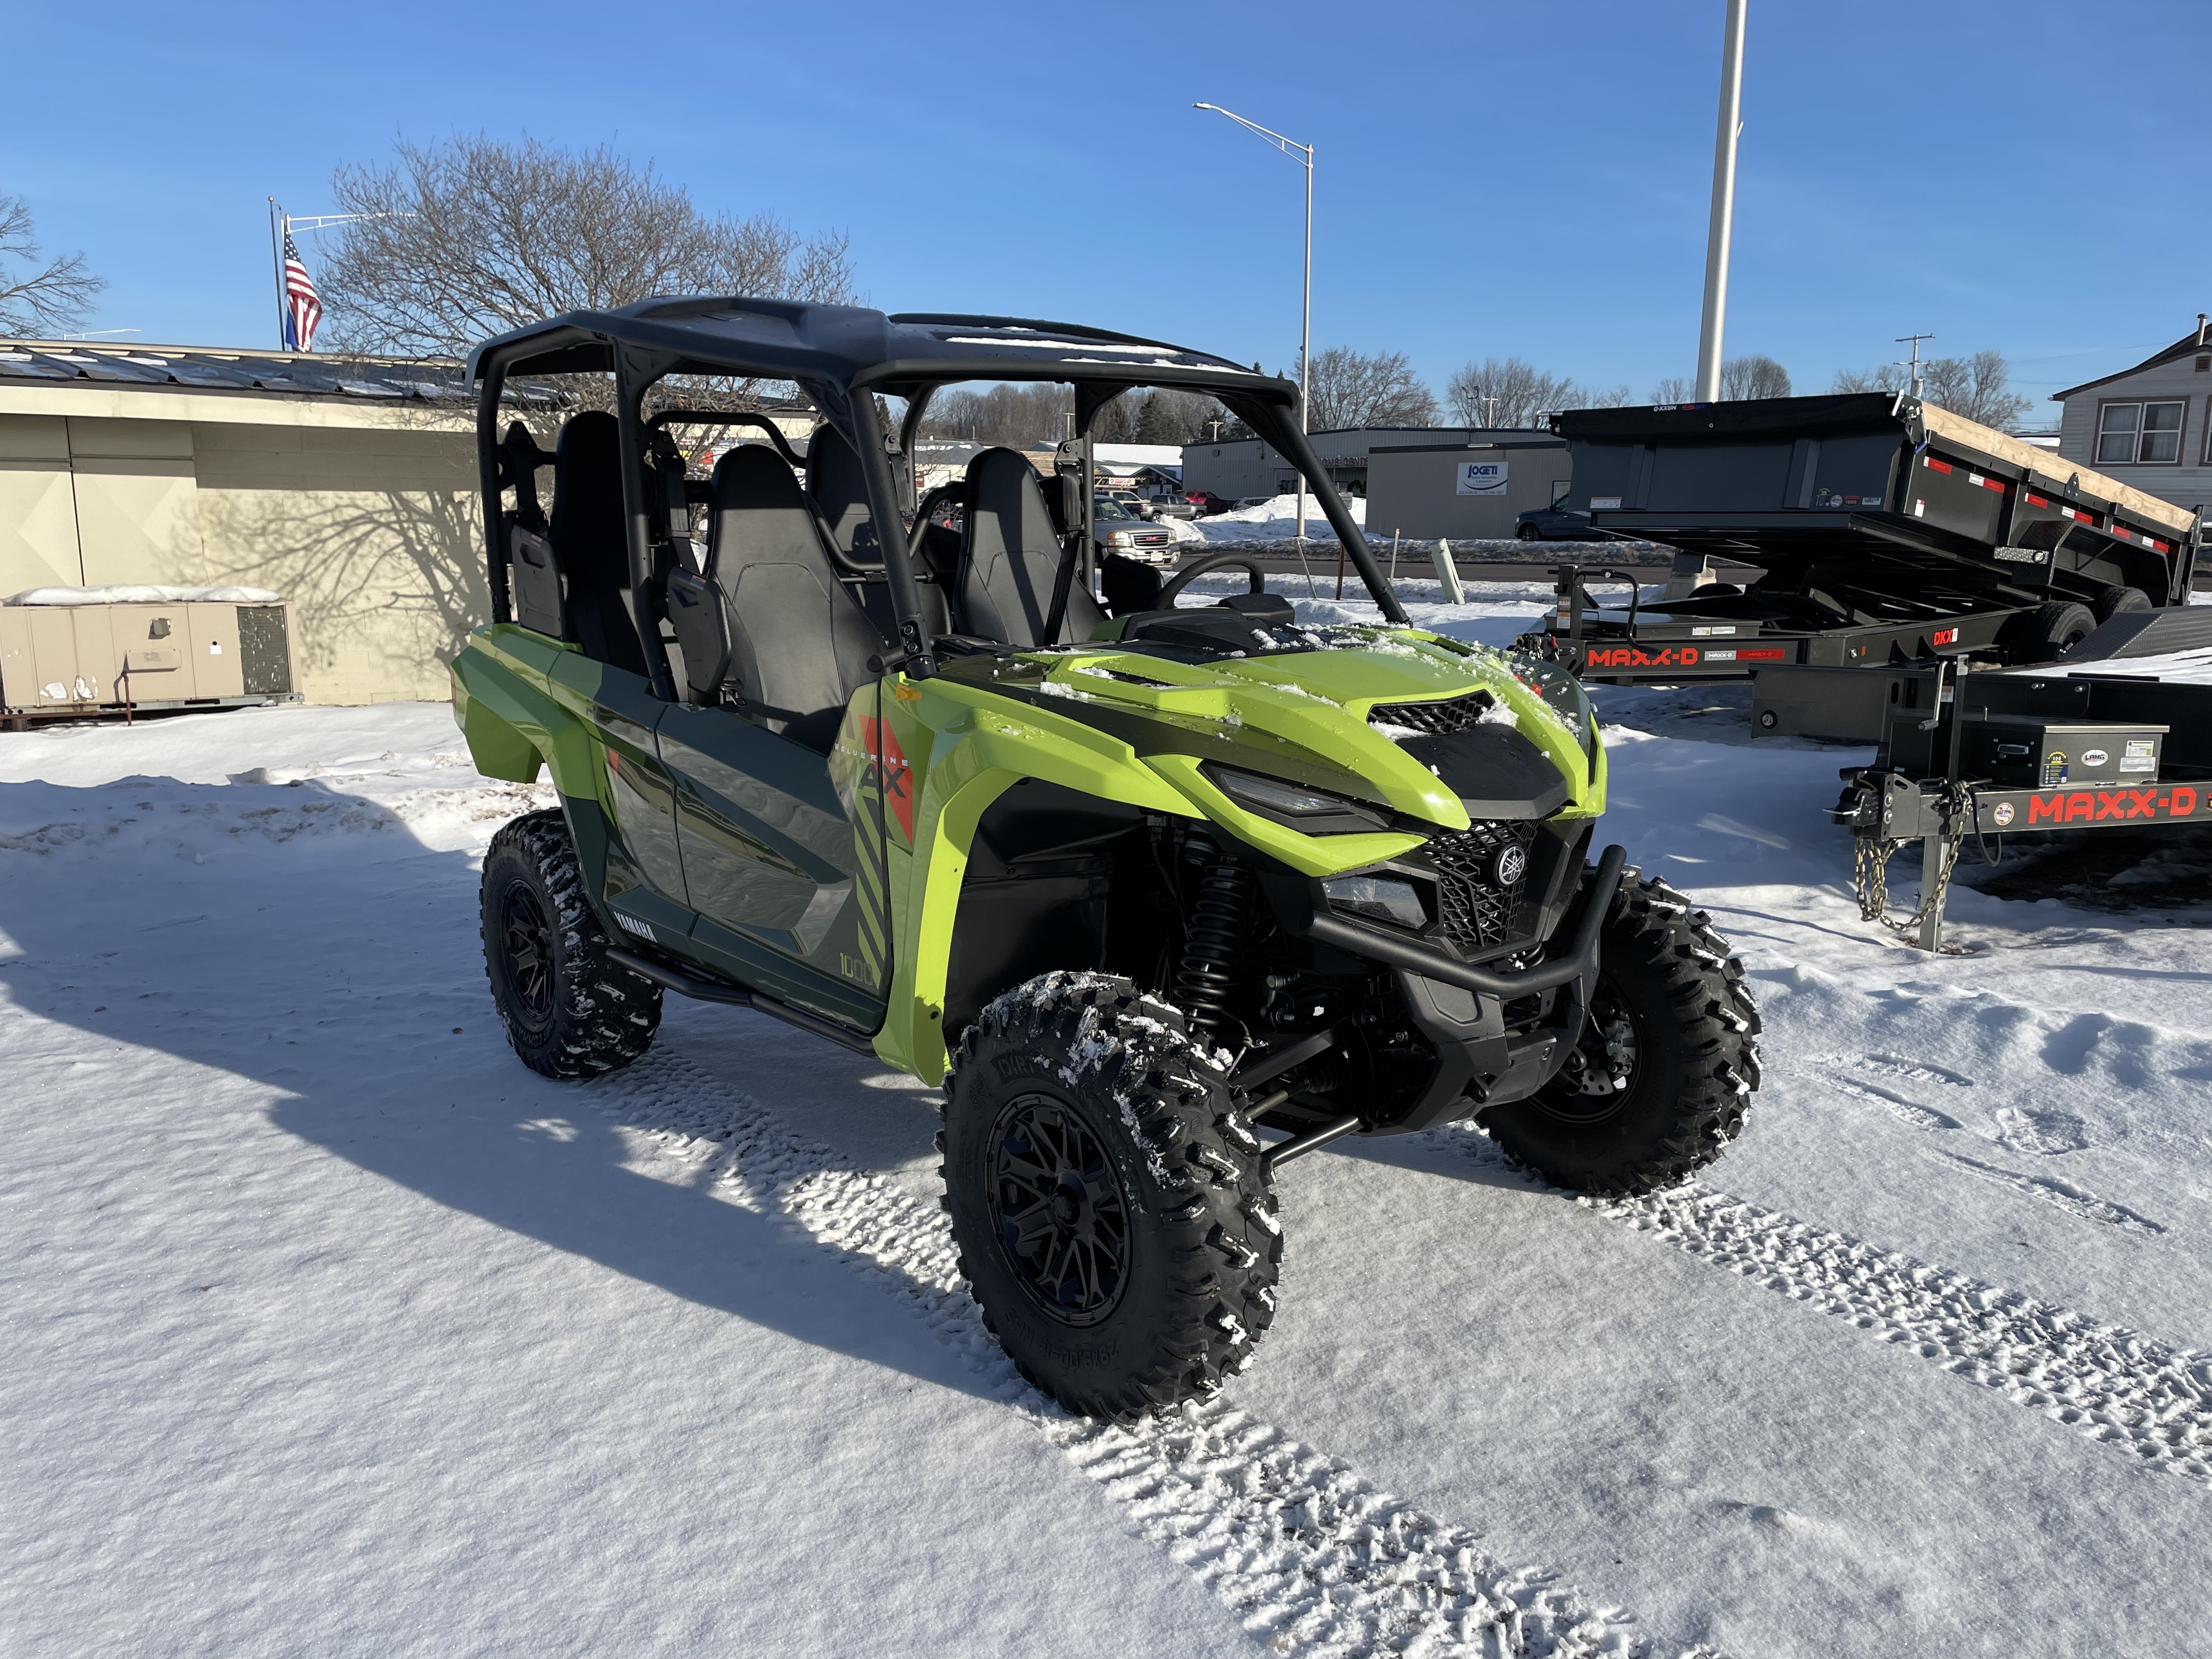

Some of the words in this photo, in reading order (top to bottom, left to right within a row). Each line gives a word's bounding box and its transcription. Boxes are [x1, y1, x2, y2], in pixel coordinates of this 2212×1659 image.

[1934, 630, 1953, 646] DKX
[1588, 647, 1699, 667] MAXX-D
[834, 743, 909, 766] WOLVERINE
[2028, 787, 2197, 824] MAXX-D
[613, 911, 658, 943] YAMAHA
[839, 952, 873, 986] 1000
